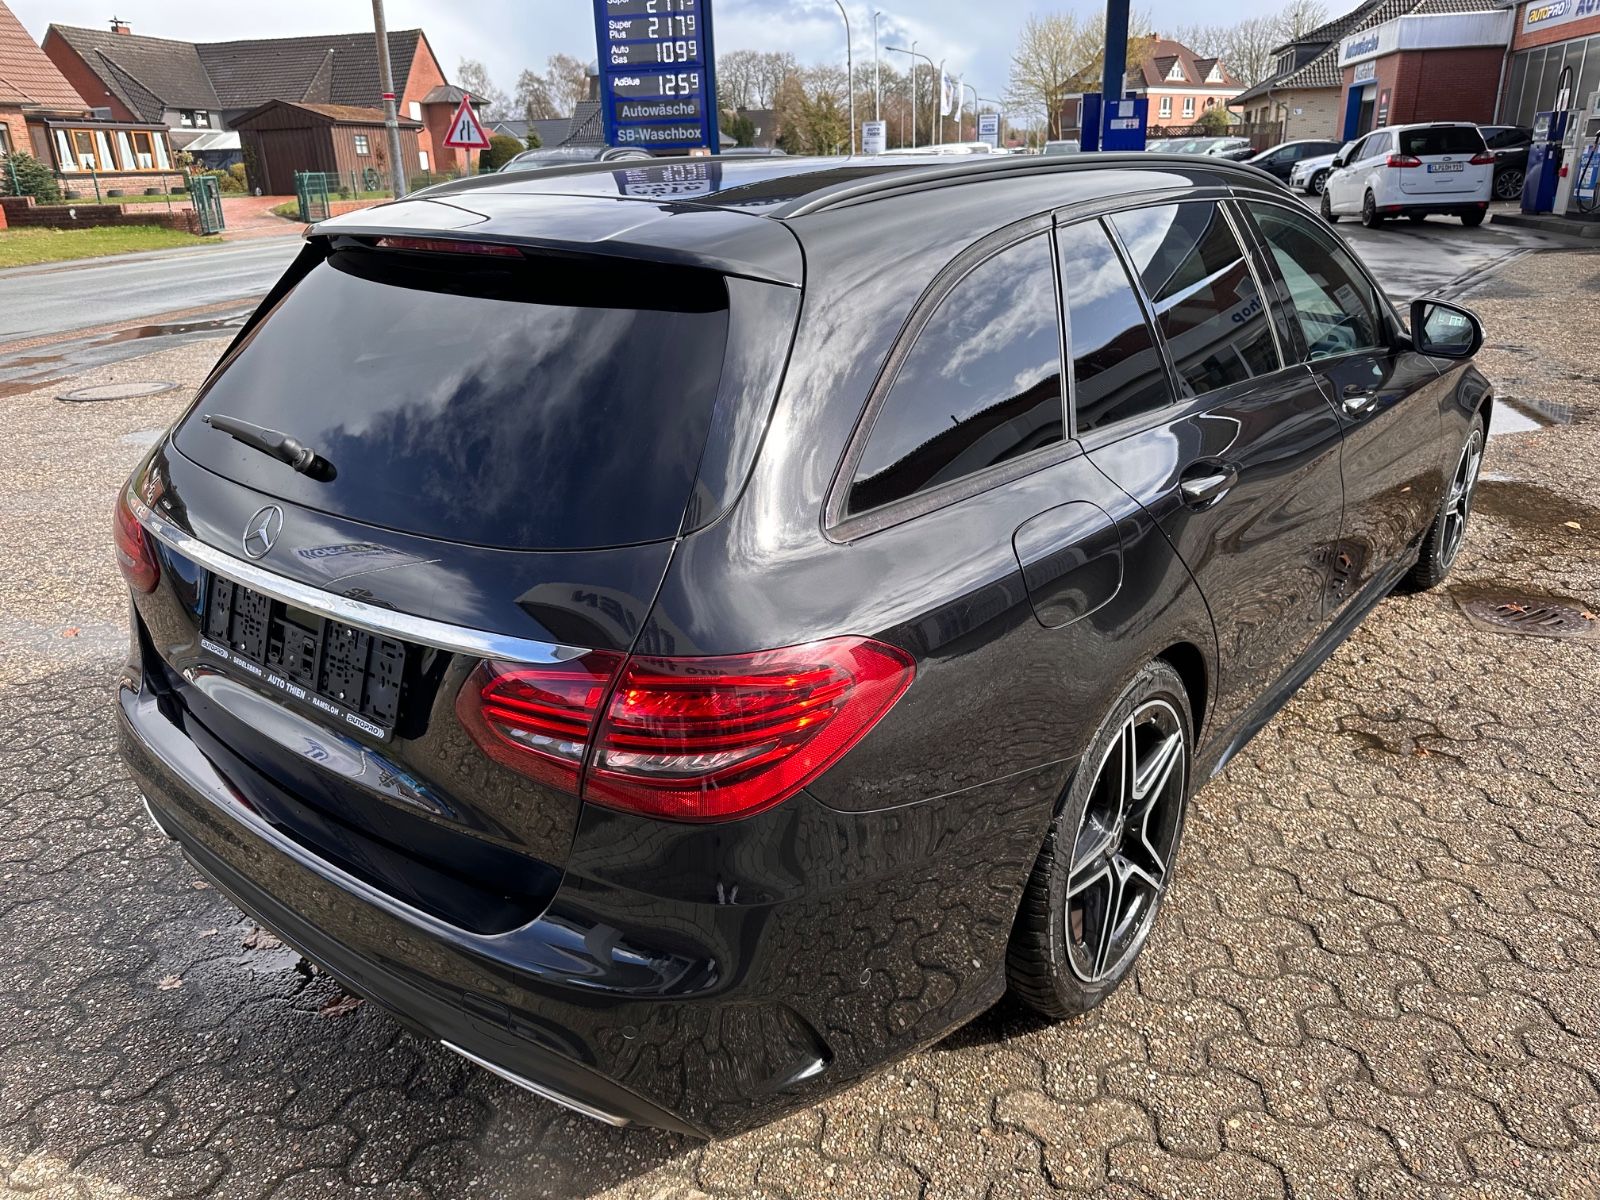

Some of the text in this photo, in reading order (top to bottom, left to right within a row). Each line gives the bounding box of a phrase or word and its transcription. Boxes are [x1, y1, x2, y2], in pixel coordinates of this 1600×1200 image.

[609, 20, 632, 30] Super
[609, 30, 627, 39] Plus
[611, 45, 629, 54] Auto
[611, 55, 628, 64] Gas
[613, 77, 640, 87] AdBlue
[622, 103, 695, 118] Autowäsche
[617, 127, 702, 142] SB-Waschbox
[268, 674, 285, 689] AUTO
[286, 683, 306, 700] THIEN
[312, 698, 339, 715] RAMSLOH
